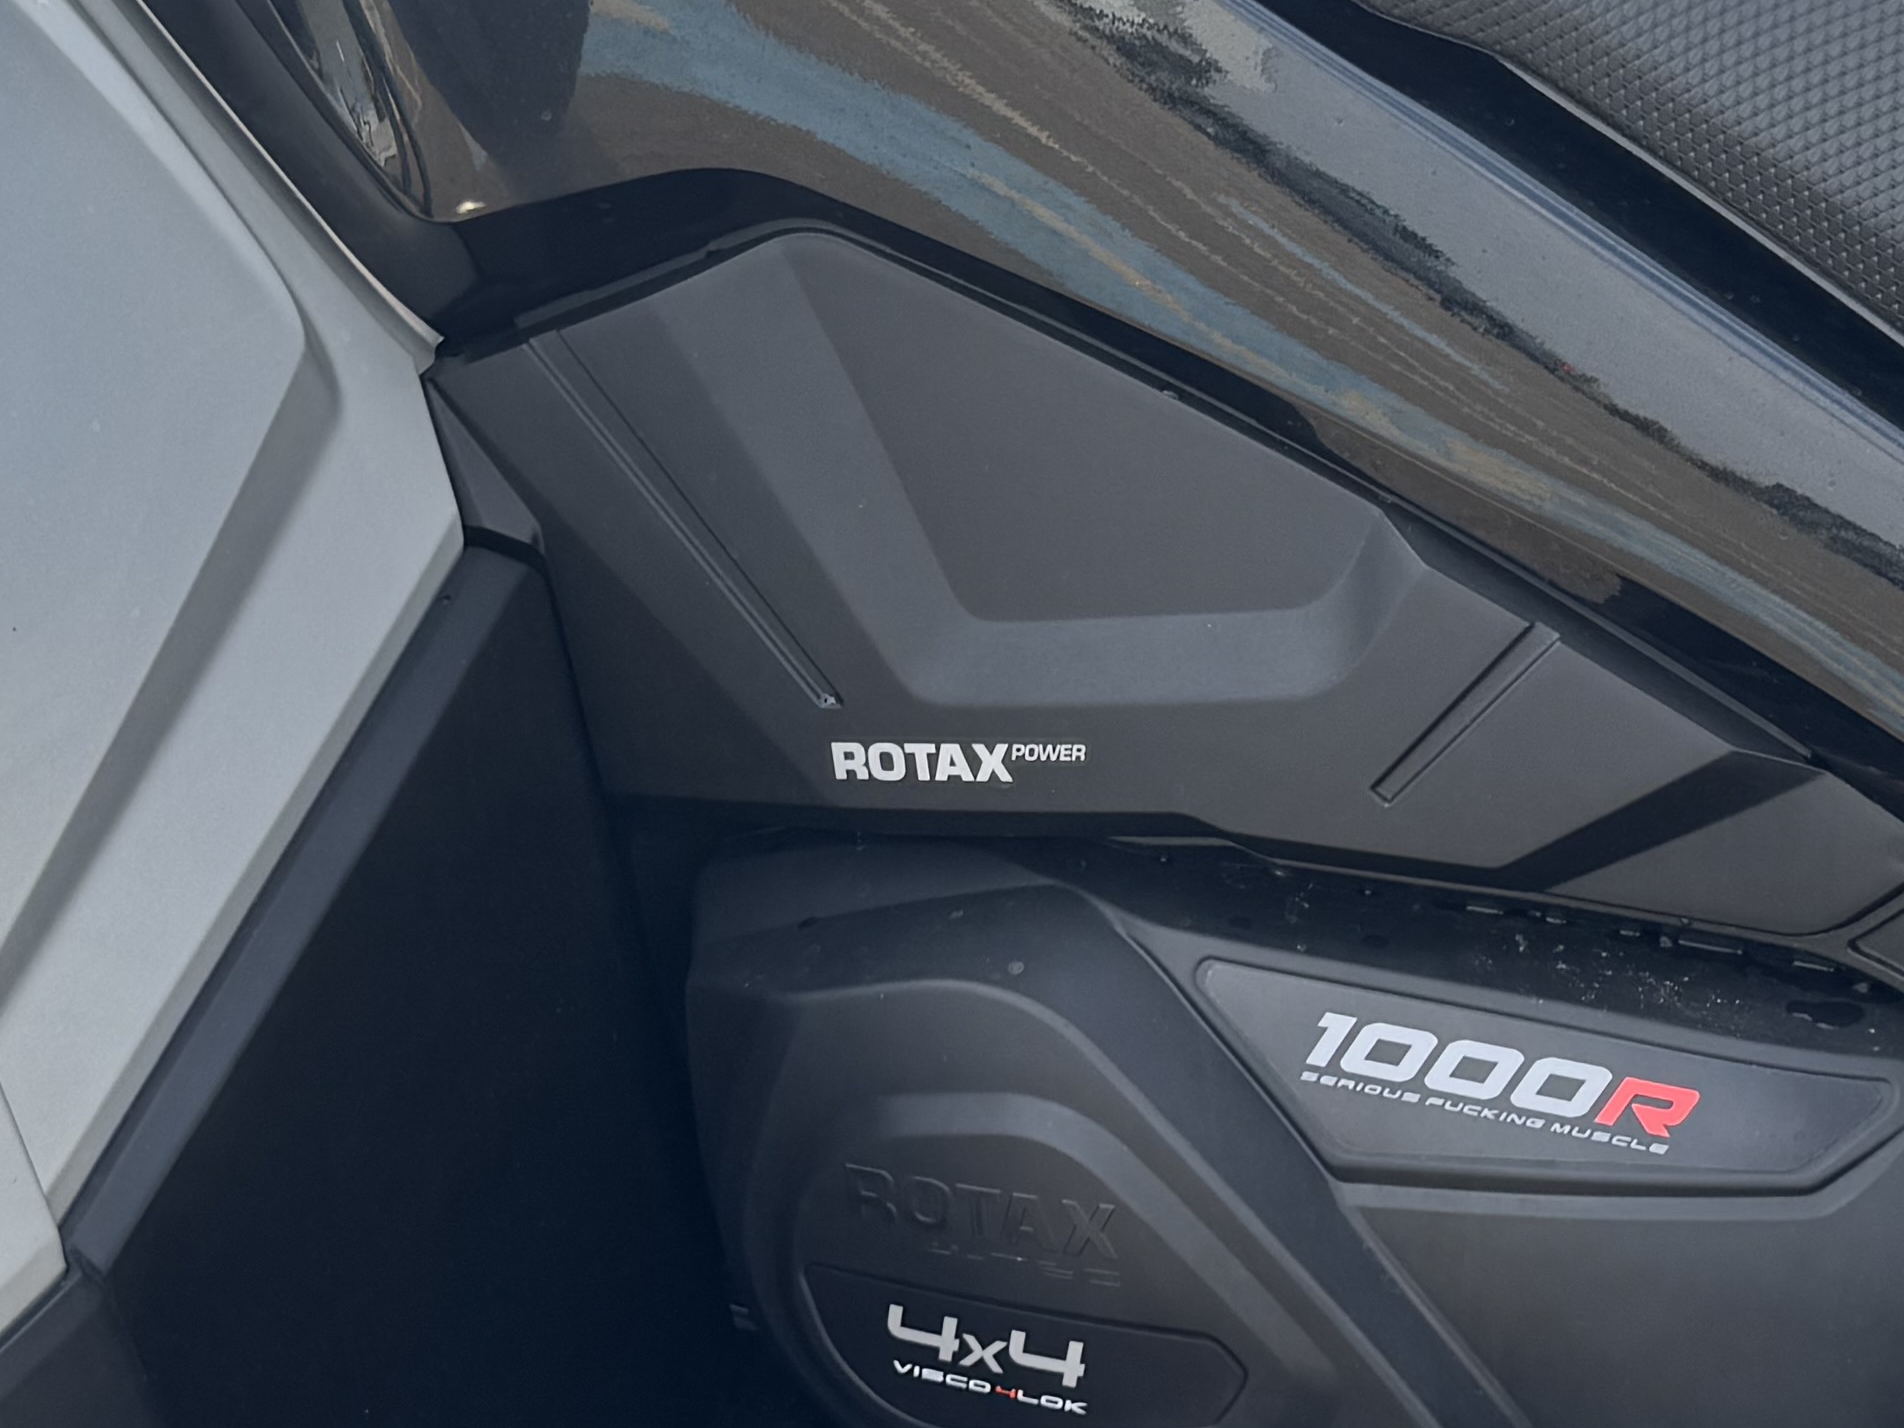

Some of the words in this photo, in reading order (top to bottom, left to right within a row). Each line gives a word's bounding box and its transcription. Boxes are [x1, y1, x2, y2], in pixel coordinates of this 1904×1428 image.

[831, 741, 1014, 783] ROTAX
[1011, 743, 1087, 762] POWER
[1300, 1070, 1422, 1104] SERIOUS
[1424, 1095, 1547, 1130] FUCKING
[1549, 1121, 1670, 1156] MUSCLE
[1304, 1011, 1701, 1139] 1000R
[844, 1162, 1120, 1260] ROTAX
[886, 1303, 1087, 1388] 4x4
